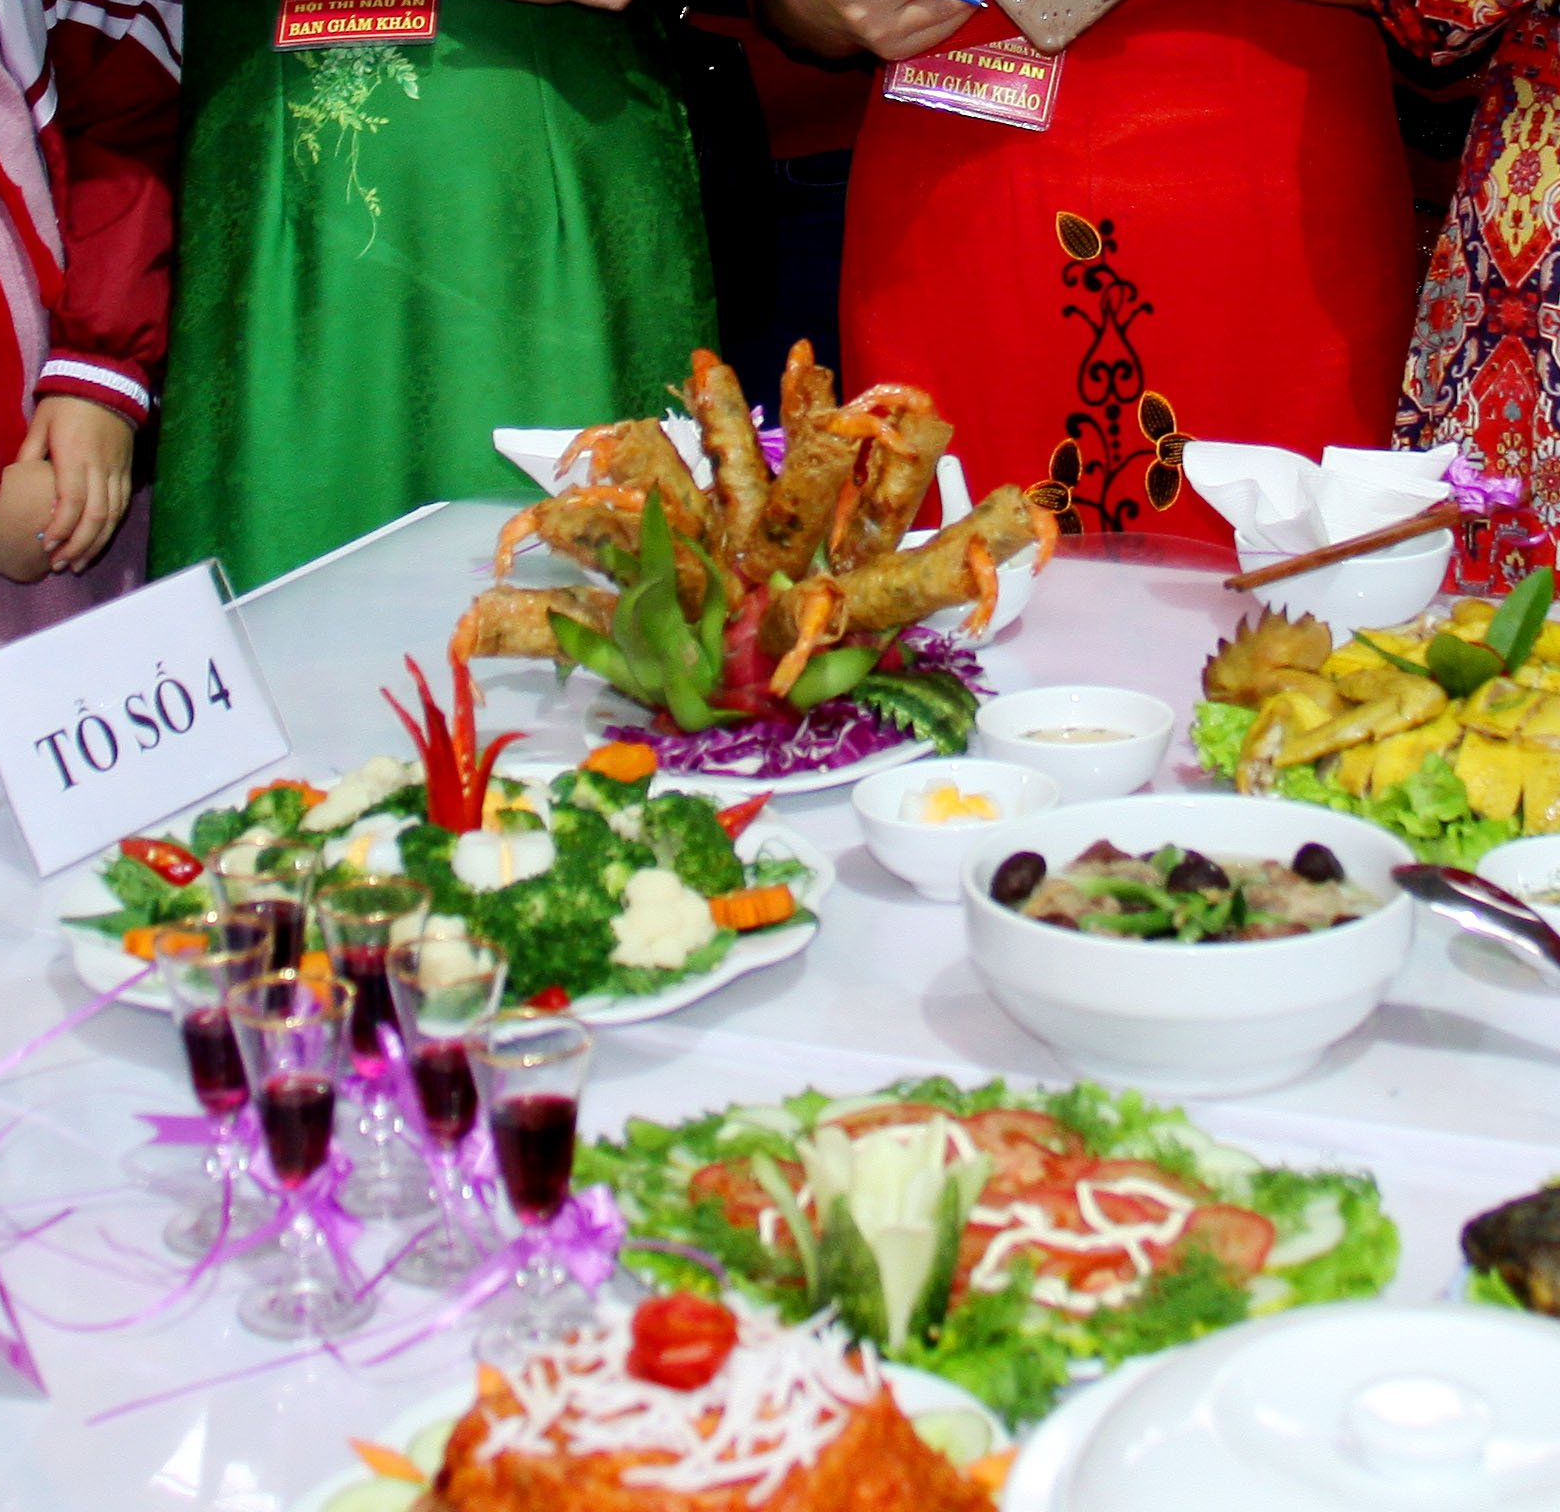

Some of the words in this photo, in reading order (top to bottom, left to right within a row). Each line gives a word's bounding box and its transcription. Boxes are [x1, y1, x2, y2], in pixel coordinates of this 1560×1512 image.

[289, 21, 324, 36] BAN
[327, 15, 372, 32] GIÁM
[375, 10, 426, 30] KHẢO
[294, 2, 322, 13] HỘI
[328, 0, 354, 9] THI
[903, 66, 939, 88] BAN
[942, 75, 989, 100] GIÁM
[991, 85, 1040, 111] KHẢO
[34, 697, 118, 792] TỔ
[124, 660, 195, 752] SỐ
[207, 657, 232, 710] 4
